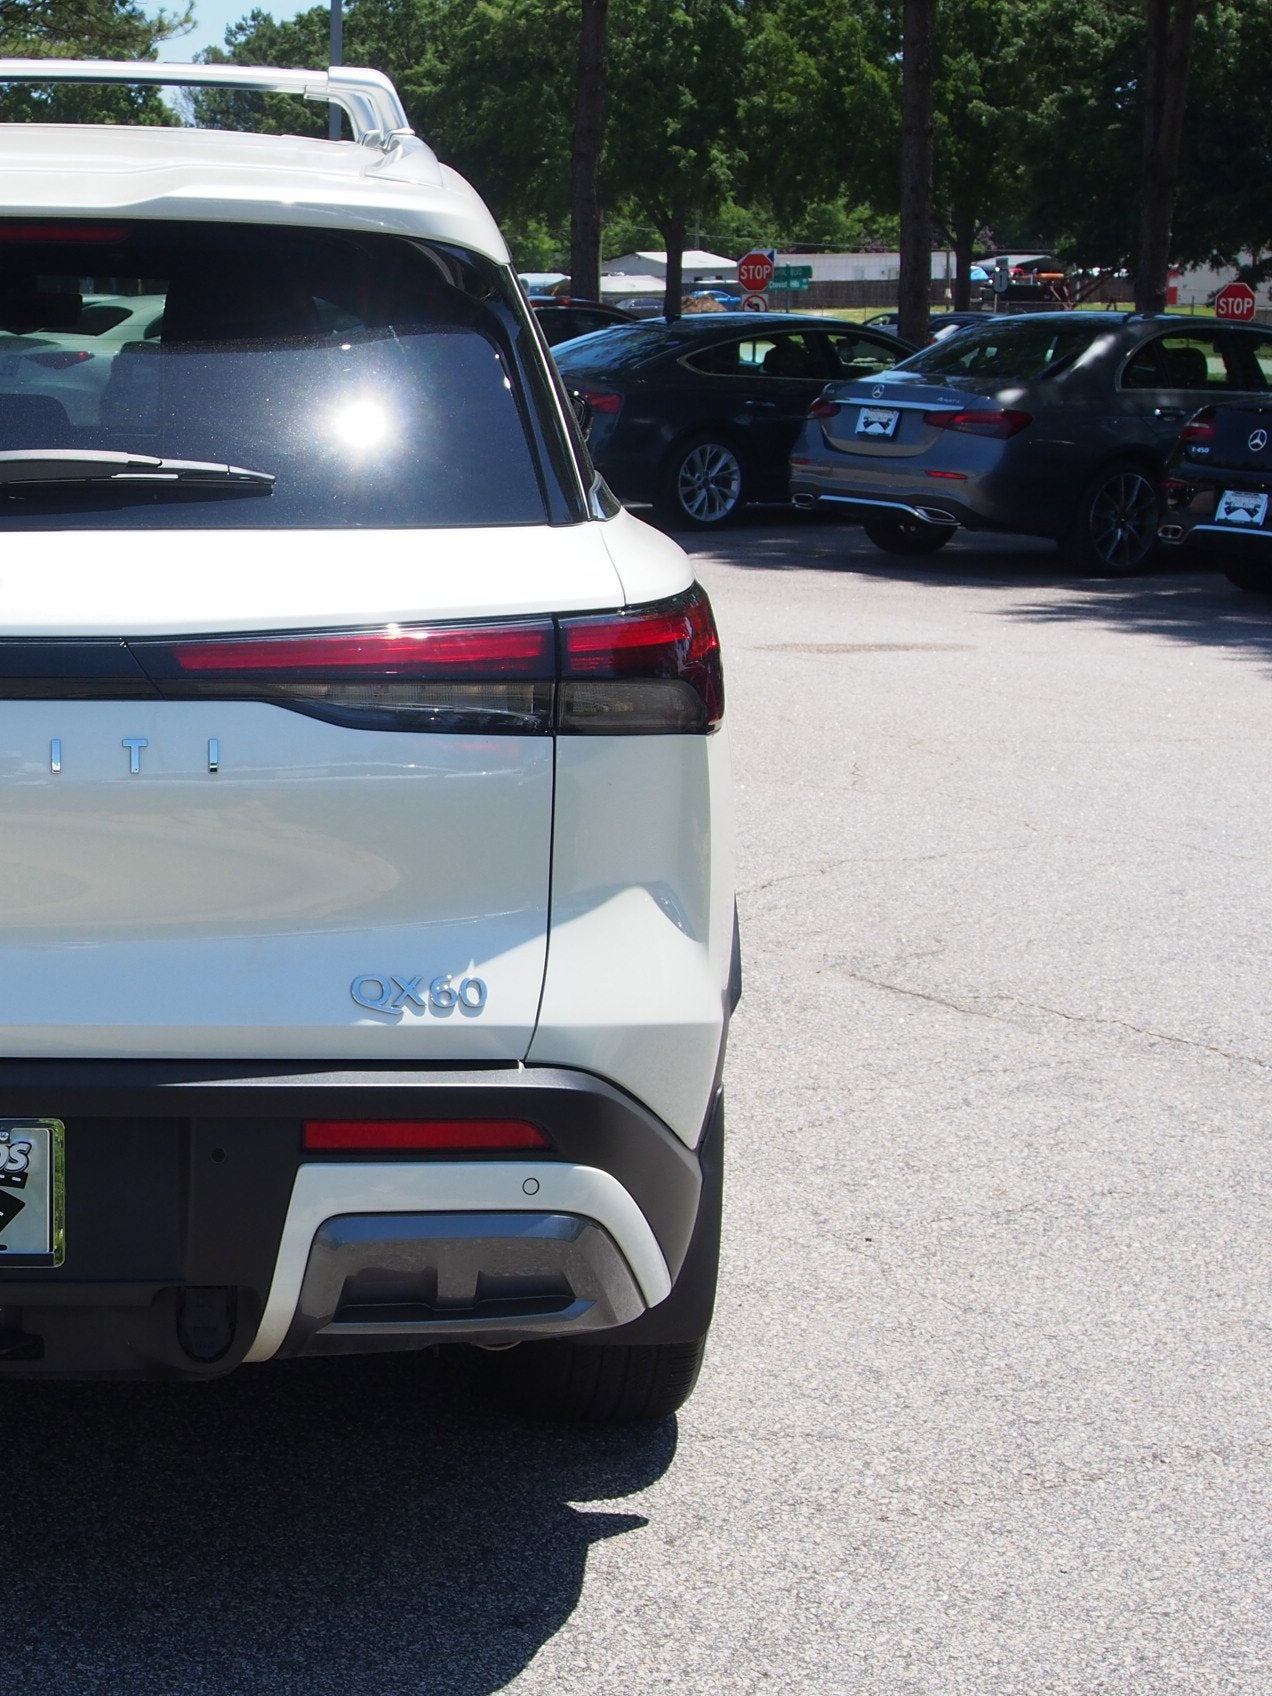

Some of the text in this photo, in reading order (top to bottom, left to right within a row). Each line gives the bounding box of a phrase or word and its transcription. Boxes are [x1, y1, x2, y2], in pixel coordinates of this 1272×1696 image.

[740, 264, 771, 280] STOP
[1219, 298, 1253, 315] STOP
[350, 973, 488, 1015] QX60
